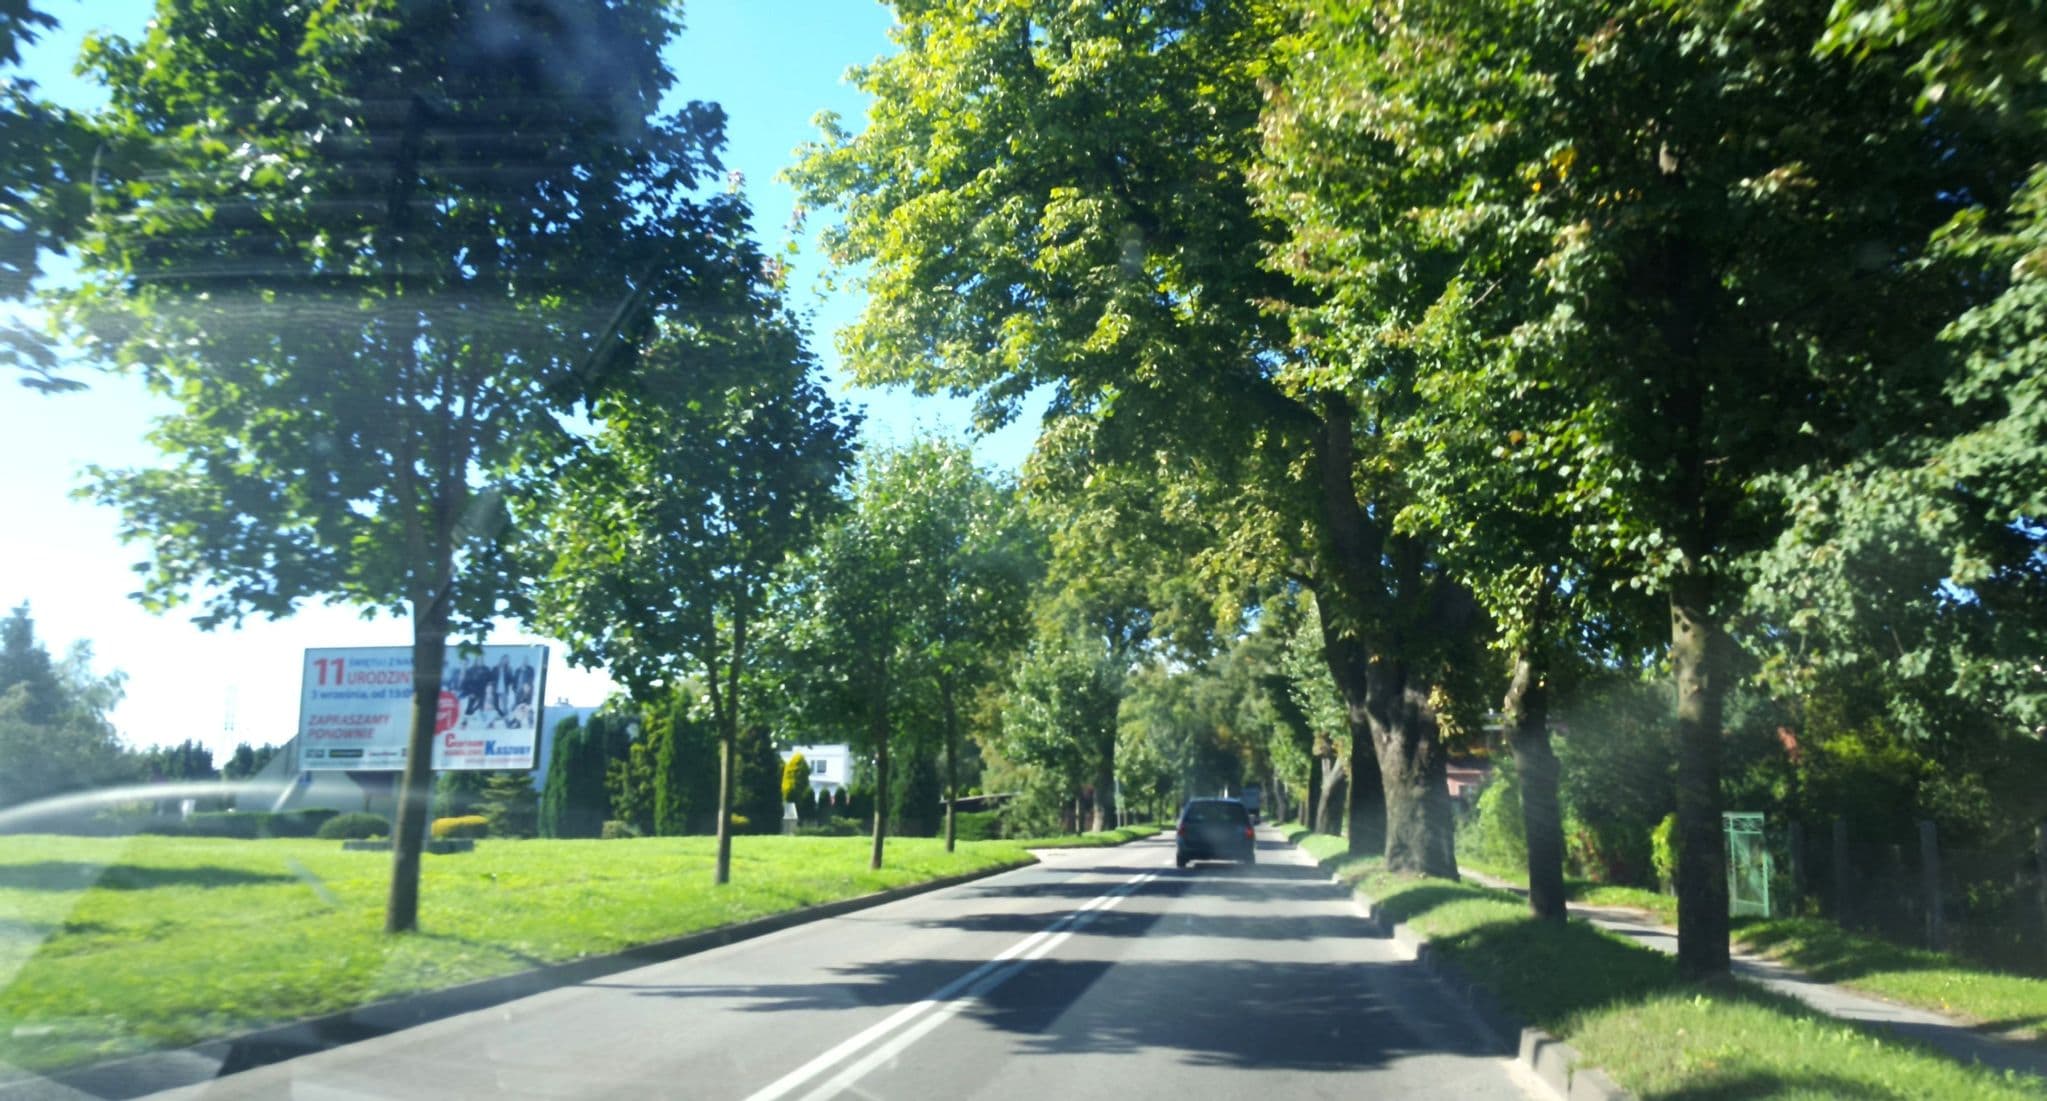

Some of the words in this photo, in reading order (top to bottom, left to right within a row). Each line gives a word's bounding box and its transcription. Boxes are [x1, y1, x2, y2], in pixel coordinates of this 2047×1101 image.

[313, 657, 345, 686] 11
[348, 671, 413, 685] URODZIN
[309, 714, 390, 726] ZAPRASZAMY
[308, 727, 374, 739] PONOWNIE
